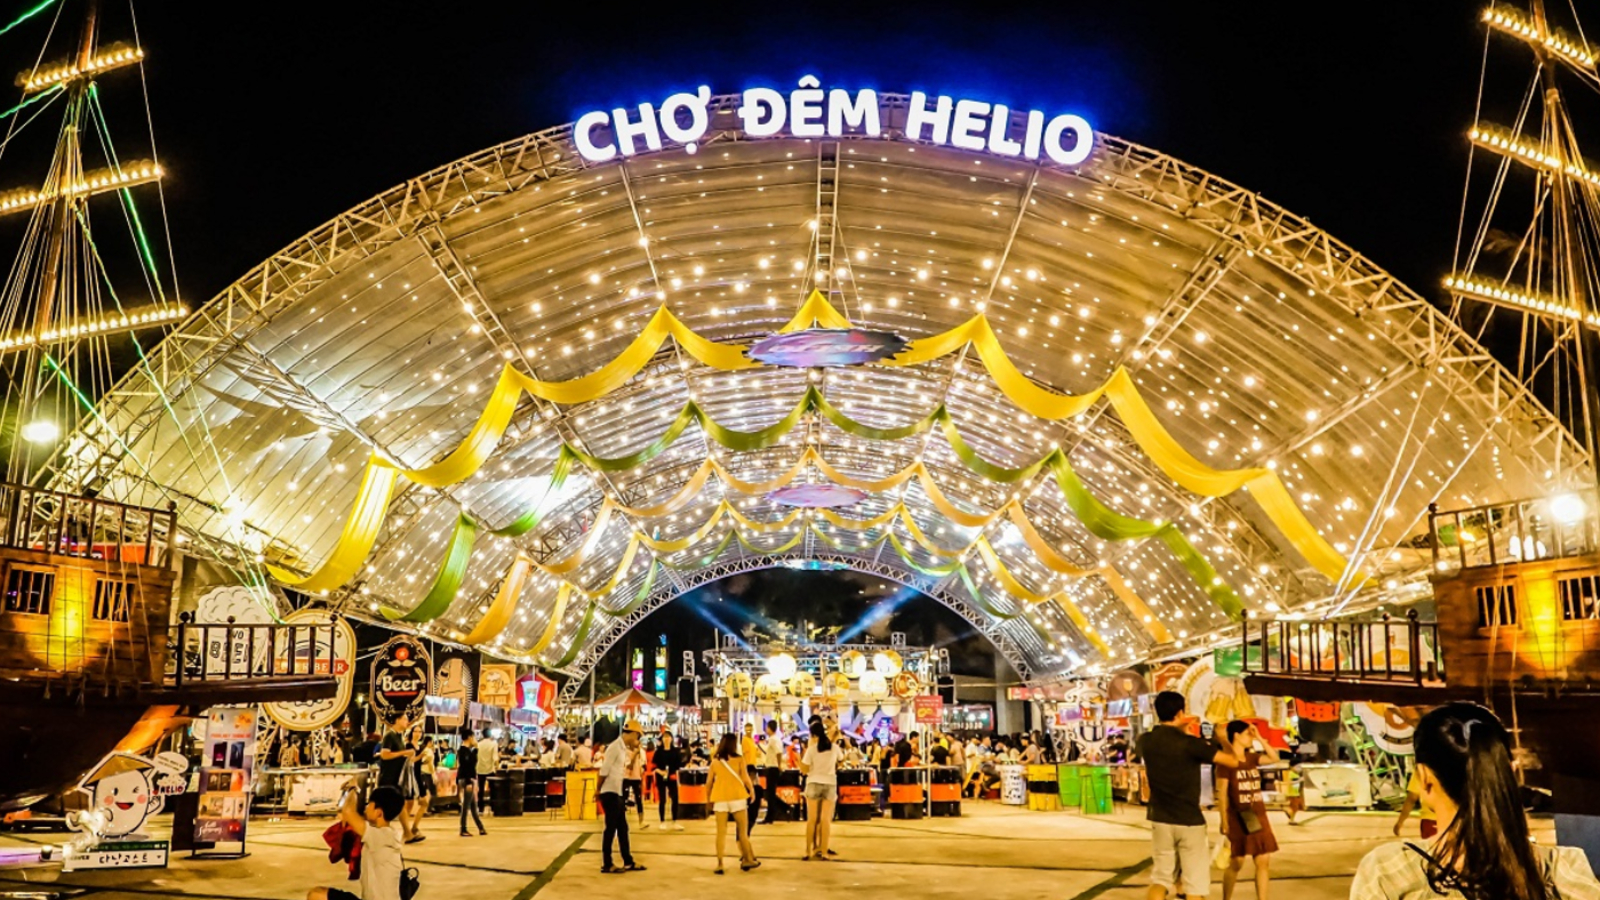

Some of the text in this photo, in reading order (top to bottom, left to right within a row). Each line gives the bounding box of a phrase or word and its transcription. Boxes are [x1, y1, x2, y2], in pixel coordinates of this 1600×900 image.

[573, 74, 1094, 165] CHỢ ĐÊM HELIO
[314, 661, 345, 673] BER
[382, 675, 421, 691] Beer
